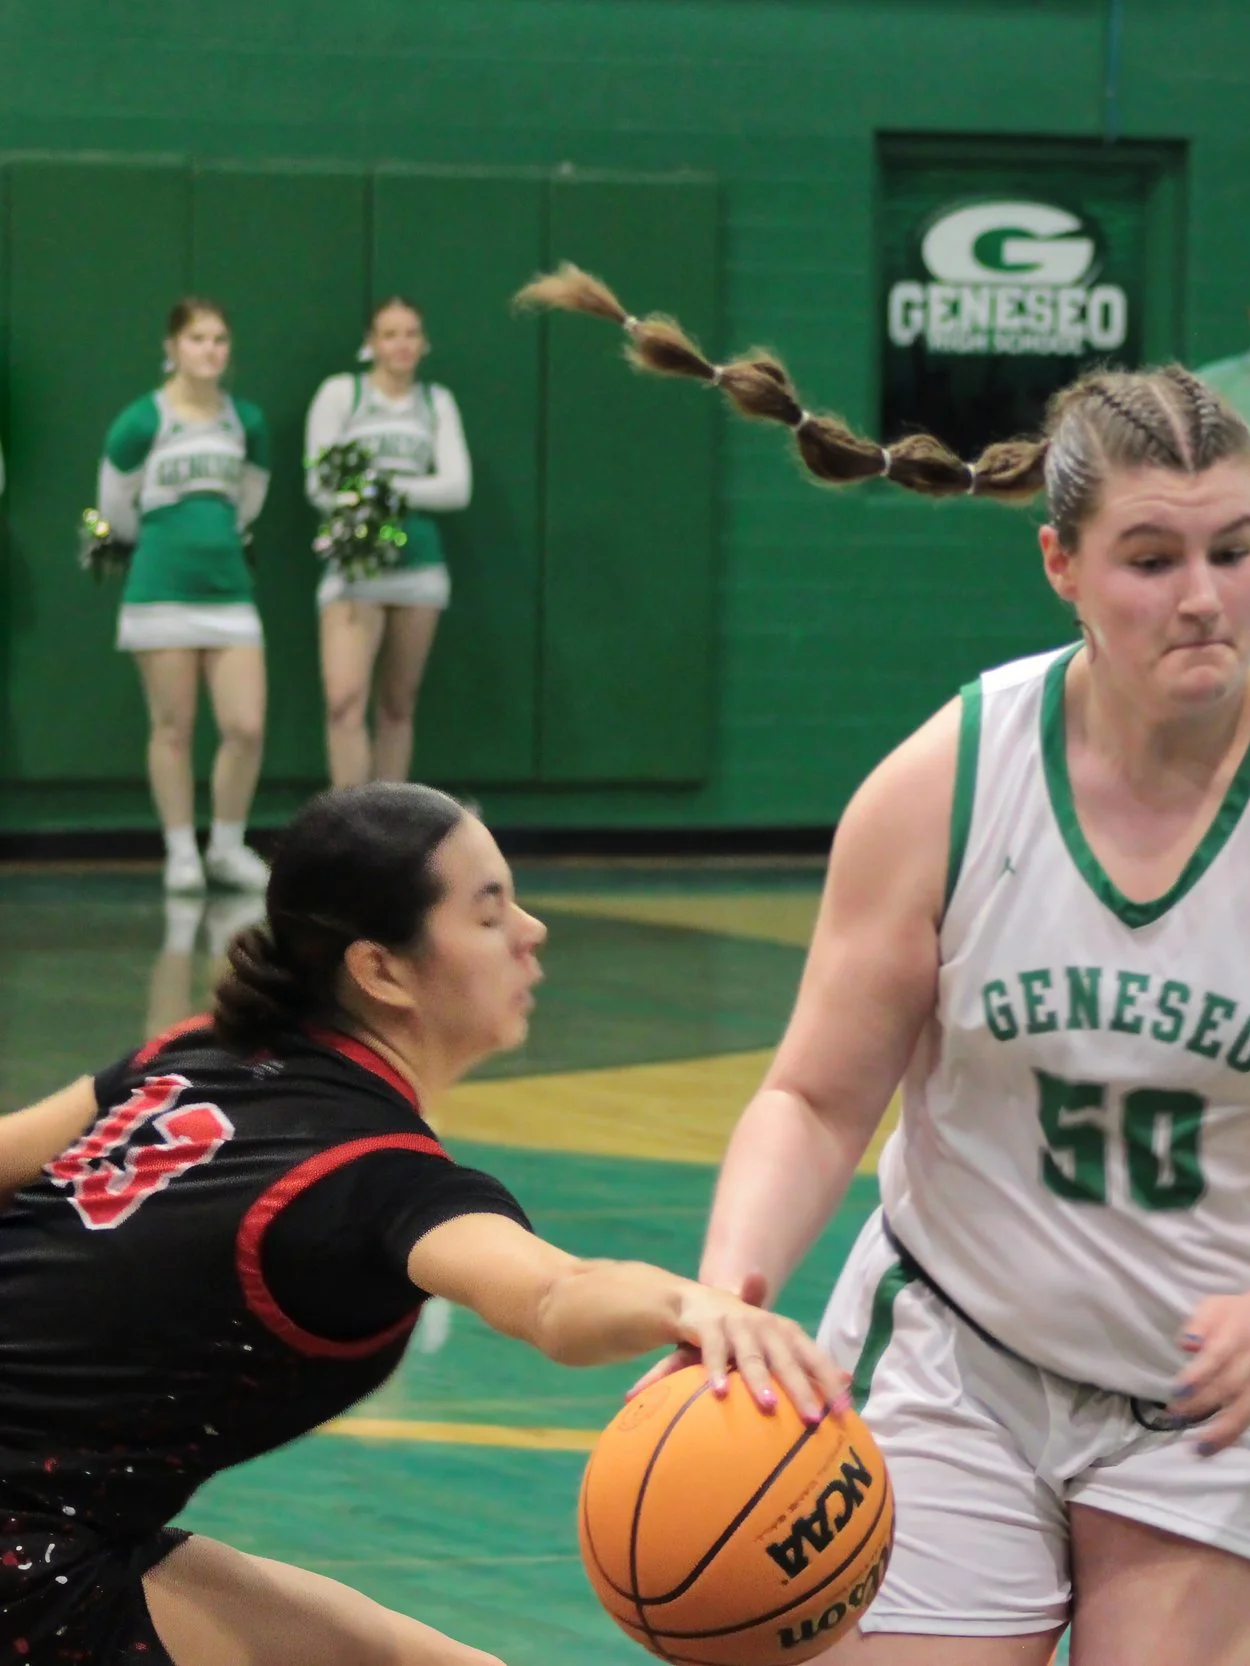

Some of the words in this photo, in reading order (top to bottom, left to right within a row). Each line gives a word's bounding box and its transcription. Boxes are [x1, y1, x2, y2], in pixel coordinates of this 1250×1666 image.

[922, 201, 1094, 285] G
[888, 281, 1127, 349] GENESEO
[1033, 1066, 1209, 1212] 50
[766, 1446, 873, 1579] NCAA
[778, 1545, 890, 1648] lson
